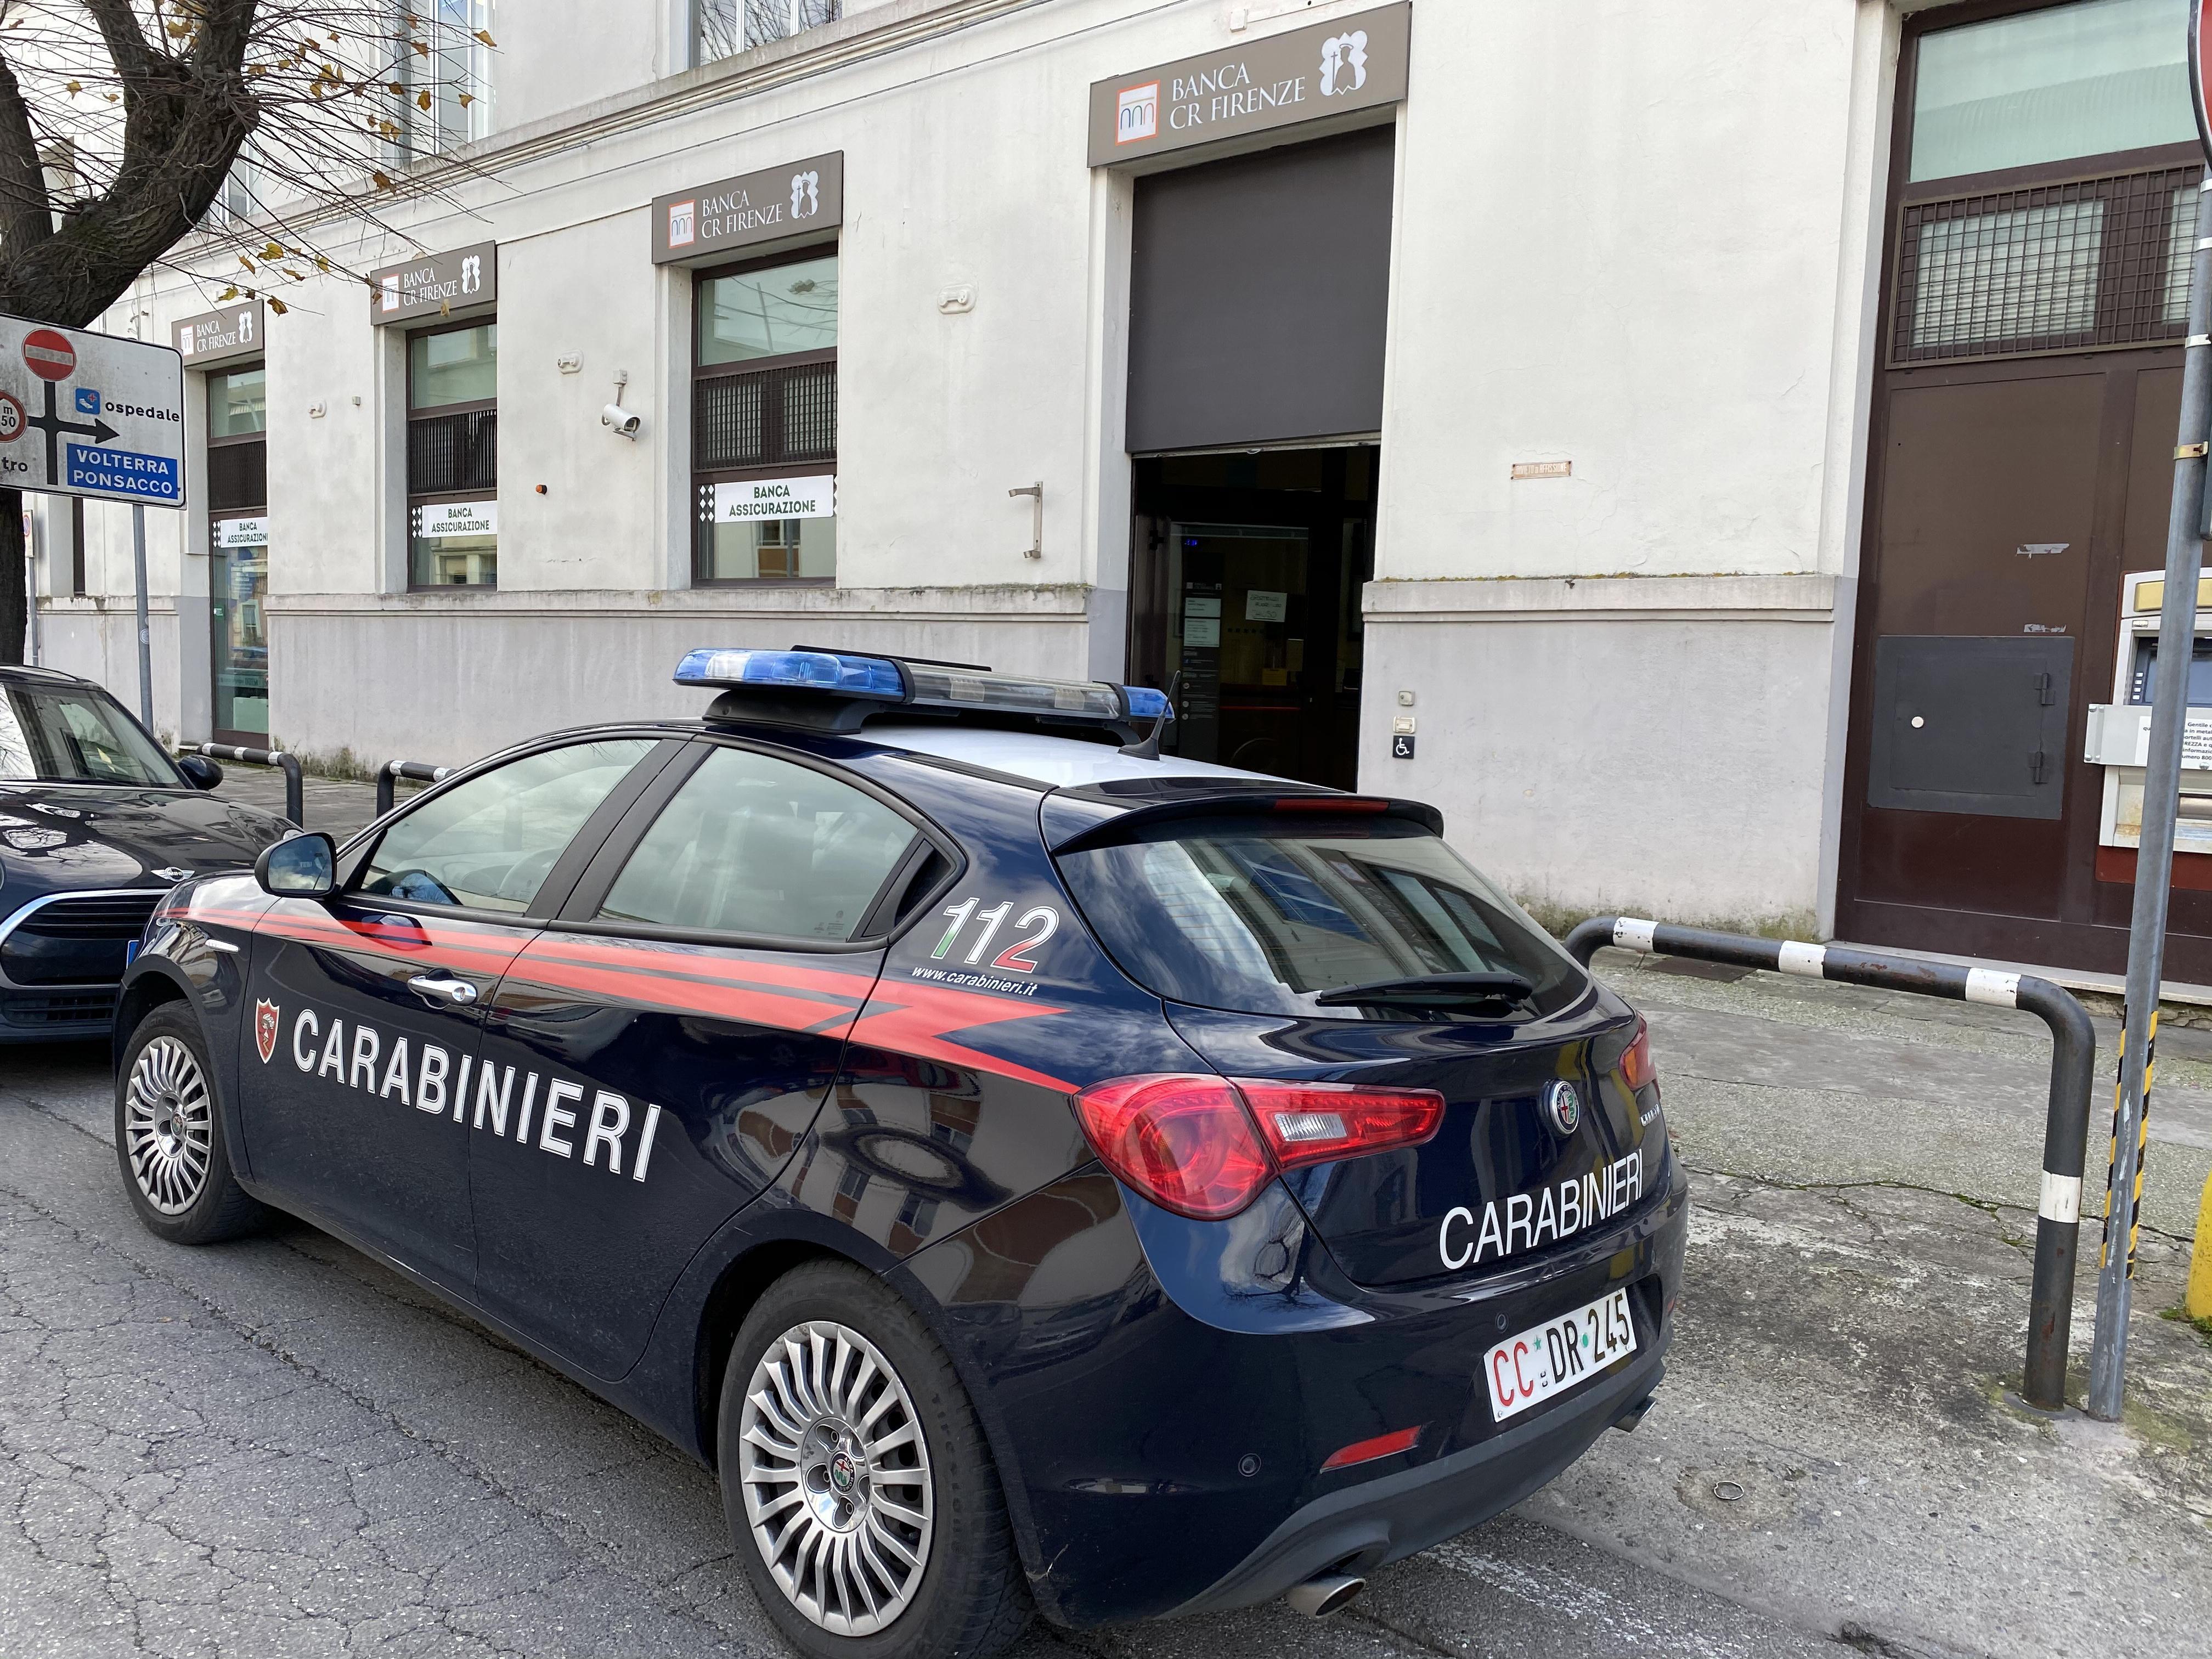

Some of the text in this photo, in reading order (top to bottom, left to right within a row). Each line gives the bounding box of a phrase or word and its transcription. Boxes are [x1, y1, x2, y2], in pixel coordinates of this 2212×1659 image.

[1172, 62, 1251, 101] BANCA
[1170, 76, 1306, 129] CR FIRENZE
[702, 189, 750, 217] BANCA
[702, 203, 783, 239] CR FIRENZE
[404, 267, 436, 288] BANCA
[403, 280, 458, 306] CR FIRENZE
[196, 320, 220, 337] BANCA
[197, 331, 236, 352] CR FIRENZE
[3, 406, 13, 415] m
[105, 402, 180, 422] ospedale
[2, 456, 28, 472] tro
[76, 449, 169, 475] VOLTERRA
[74, 470, 173, 495] PONSACCO
[754, 484, 791, 499] BANCA
[448, 507, 472, 518] BANCA
[729, 500, 816, 517] ASSICURAZIONE
[239, 522, 257, 531] BANCA
[431, 520, 489, 533] ASSICURAZIONE
[227, 533, 268, 544] ASSICURAZION
[930, 897, 1060, 974] 112
[911, 966, 1038, 996] www.carabinieri.it
[292, 1008, 661, 1183] CARABINIERI
[1440, 1148, 1642, 1269] CARABINIERI
[1493, 1293, 1629, 1407] CC DR 245
